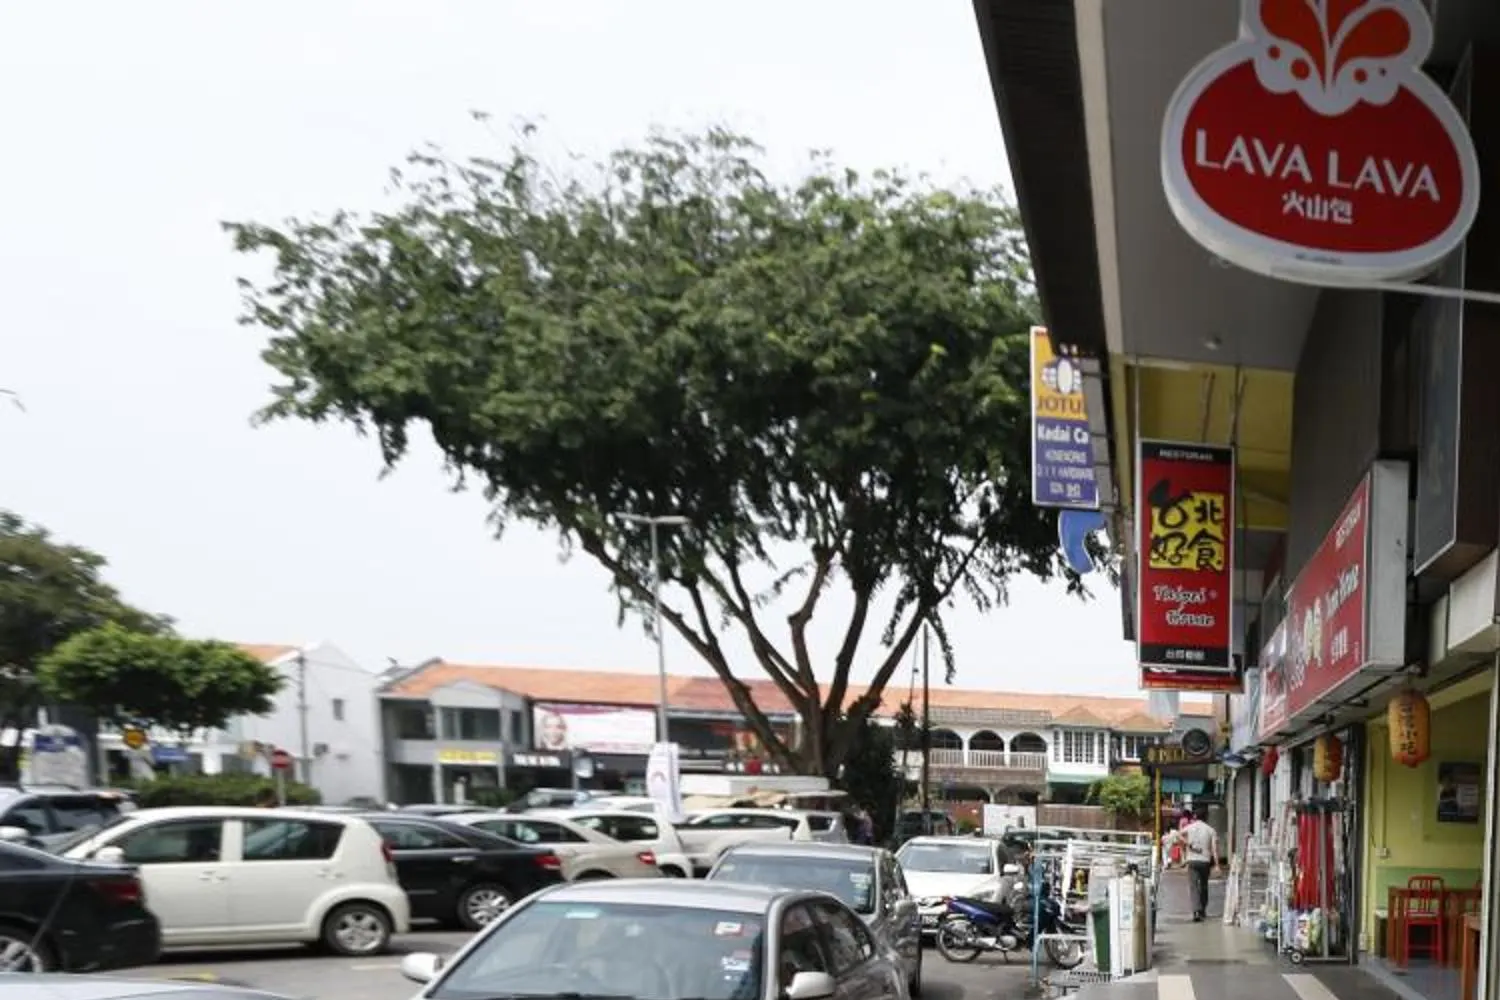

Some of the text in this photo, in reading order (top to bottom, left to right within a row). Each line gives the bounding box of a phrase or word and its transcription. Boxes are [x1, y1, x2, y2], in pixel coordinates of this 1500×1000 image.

[1195, 128, 1440, 202] LAVA LAVA
[1282, 189, 1354, 226] 火山包
[1036, 393, 1086, 417] JOTU
[1037, 423, 1071, 443] Kedai
